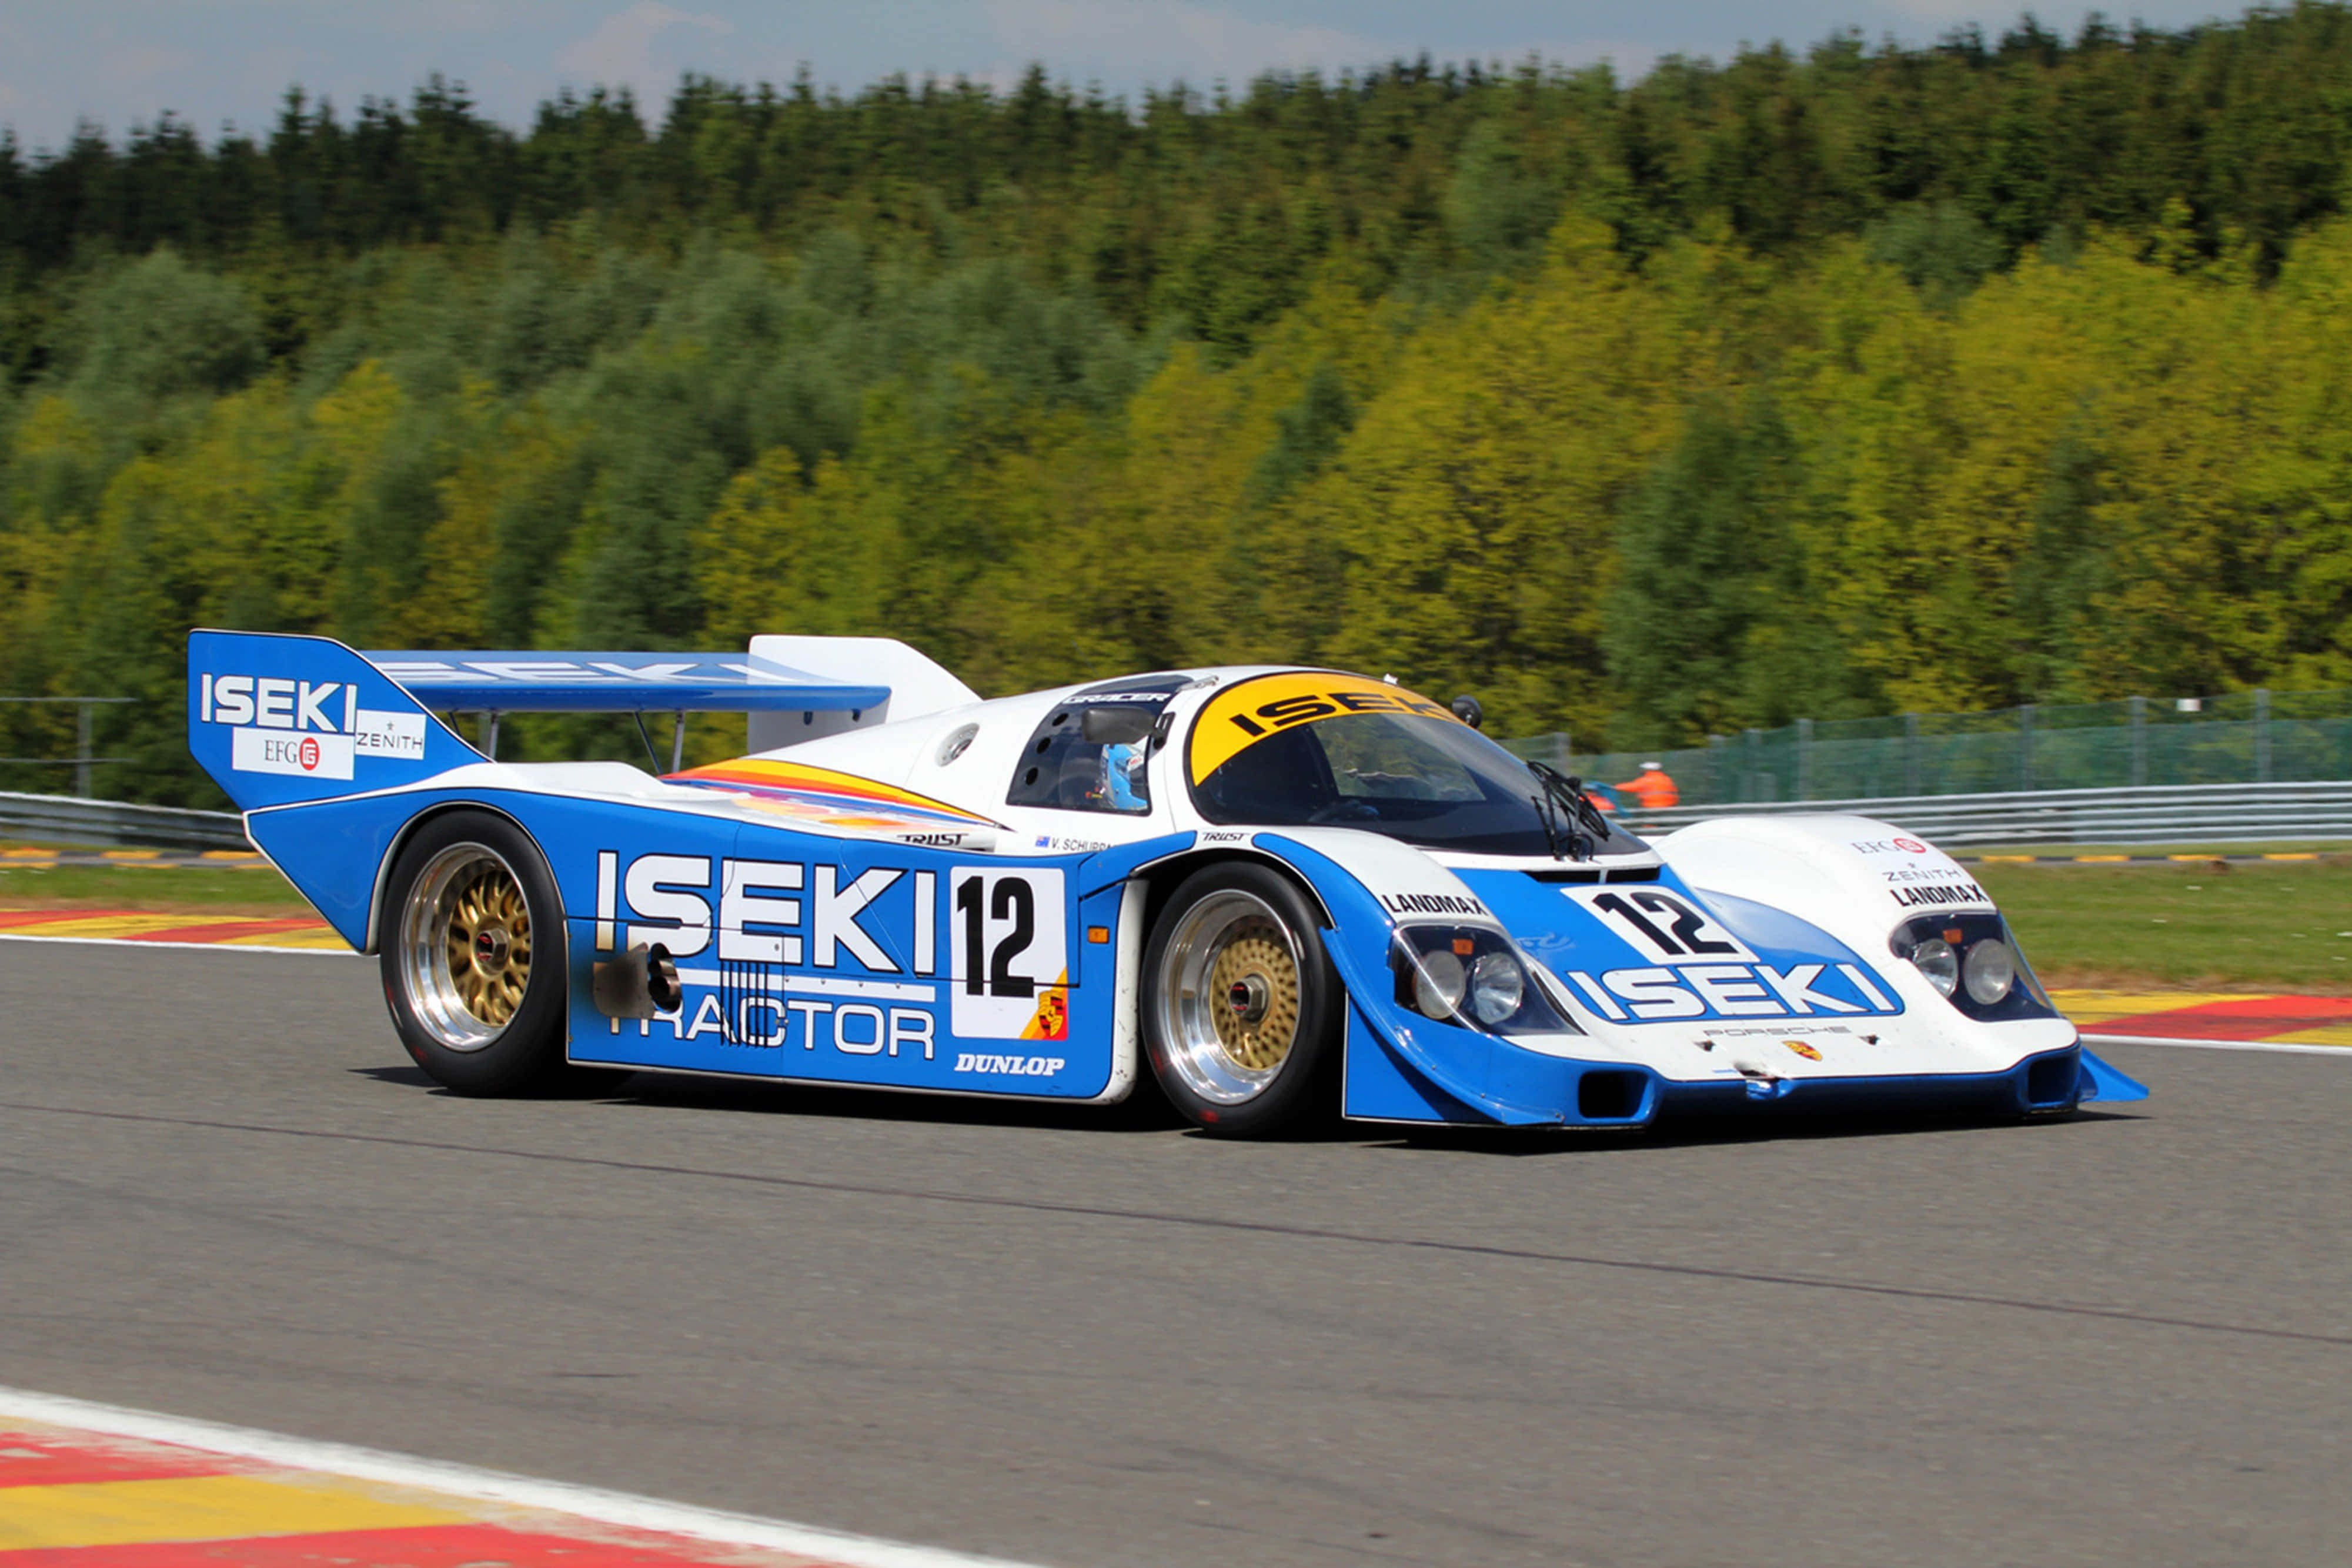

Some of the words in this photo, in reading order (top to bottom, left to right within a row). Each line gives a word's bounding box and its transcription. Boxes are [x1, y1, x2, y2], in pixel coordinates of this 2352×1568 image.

[372, 661, 802, 682] SEKI
[201, 673, 358, 733] ISEKI
[1229, 693, 1458, 737] ISEK
[265, 739, 298, 764] EFG
[357, 733, 423, 750] ZENITH
[897, 833, 969, 846] TRUST
[1063, 838, 1115, 852] SCHUPP
[1202, 832, 1251, 841] TRUST
[1851, 841, 1900, 854] EFG
[1882, 868, 1962, 882] ZENITH
[1382, 894, 1488, 916] LANDMAX
[1889, 884, 1989, 907] LANDMAX
[595, 851, 936, 976] ISEKI
[1592, 892, 1739, 955] 12
[956, 875, 1034, 998] 12
[1566, 963, 1898, 1020] ISEKI
[1703, 1026, 1852, 1036] PORSCHE
[954, 1053, 1065, 1076] DUNLOP
